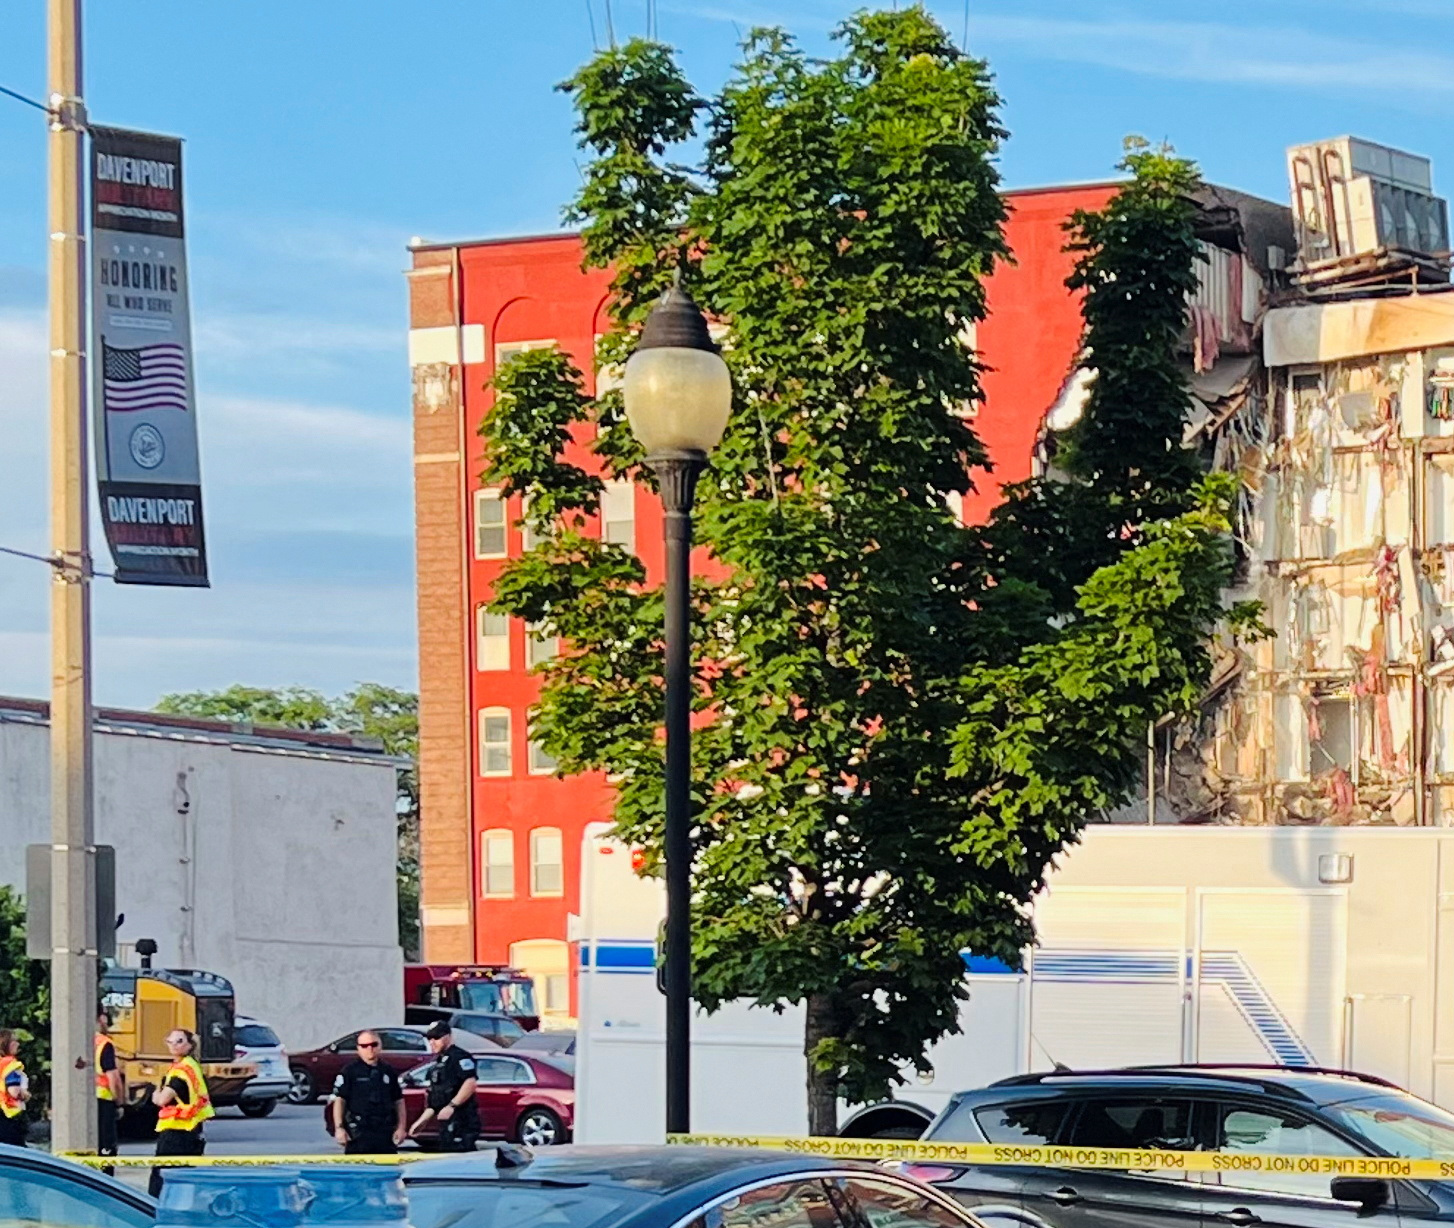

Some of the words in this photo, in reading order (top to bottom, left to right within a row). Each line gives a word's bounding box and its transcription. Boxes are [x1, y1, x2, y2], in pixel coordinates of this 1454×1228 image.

[97, 152, 175, 190] DAVENPORT
[101, 258, 178, 292] HONORING
[107, 496, 194, 525] DAVENPORT
[784, 1139, 831, 1154] CROSS
[833, 1140, 860, 1155] NOT
[864, 1142, 887, 1156] DO
[888, 1143, 916, 1157] LINE
[918, 1144, 968, 1159] POLICE
[993, 1147, 1042, 1162] CROSS
[1046, 1148, 1072, 1163] NOT
[1076, 1150, 1096, 1164] DO
[1101, 1152, 1130, 1166] LINE
[1132, 1153, 1184, 1168] POLICE
[1212, 1155, 1262, 1170] CROSS
[1264, 1156, 1294, 1171] NOT
[1298, 1157, 1319, 1172] DO
[1323, 1158, 1355, 1173] LINE
[1358, 1160, 1411, 1175] POLICE
